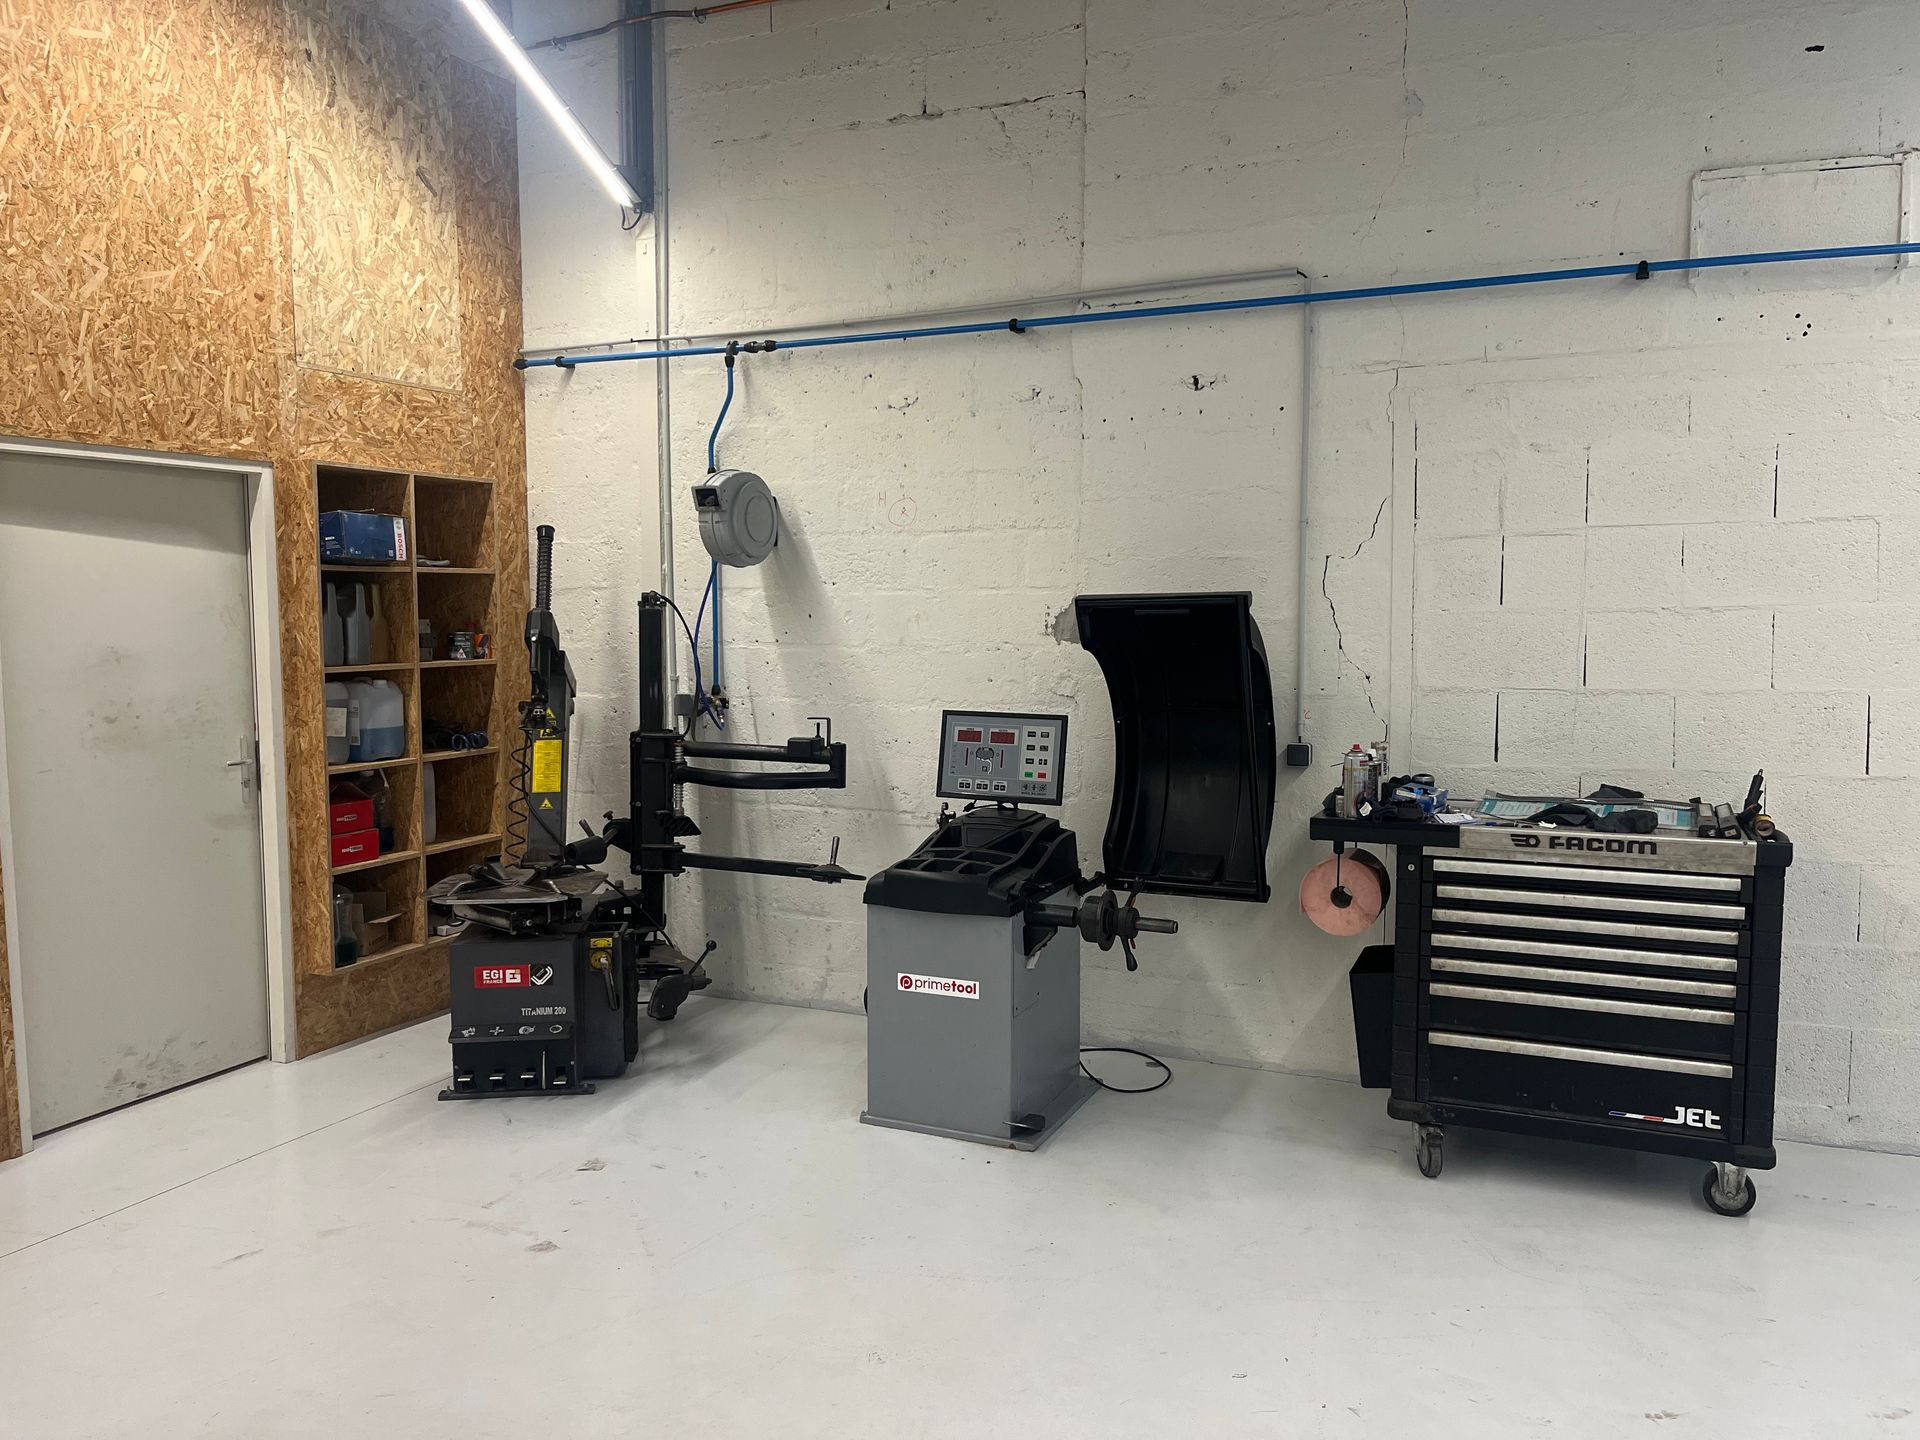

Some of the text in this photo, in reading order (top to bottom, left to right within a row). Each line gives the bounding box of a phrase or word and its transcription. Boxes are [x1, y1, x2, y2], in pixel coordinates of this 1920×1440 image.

[1548, 836, 1658, 855] FACOM
[482, 969, 504, 980] EGI
[914, 978, 977, 995] primetool
[554, 1006, 567, 1015] 200
